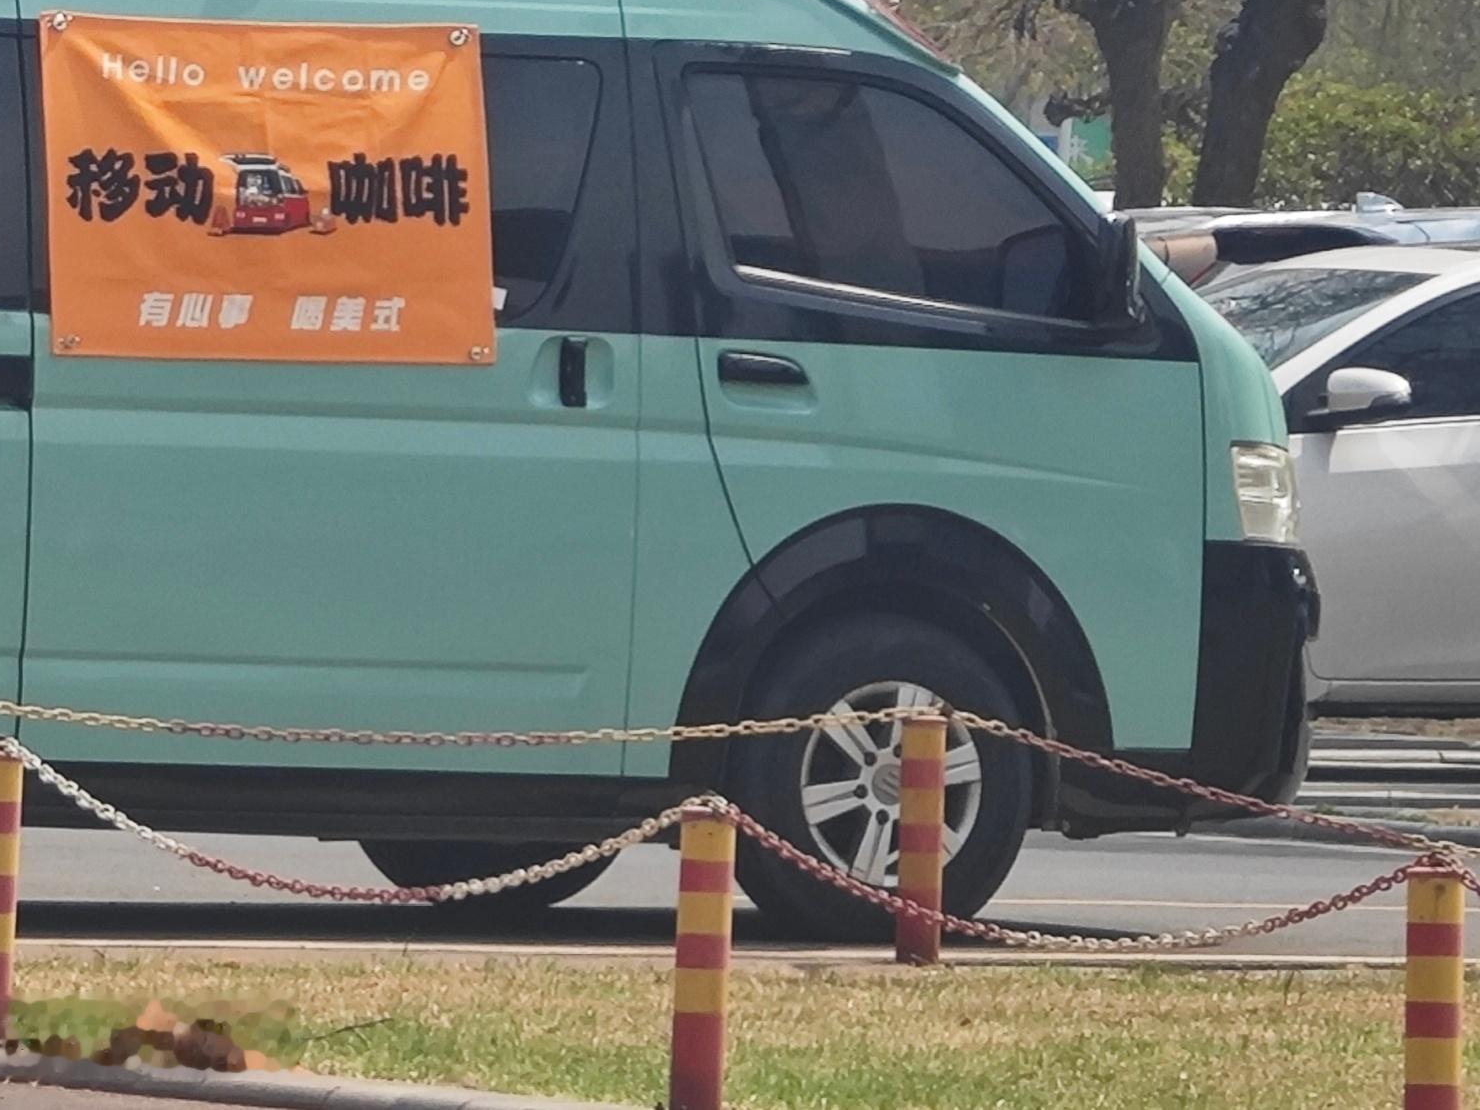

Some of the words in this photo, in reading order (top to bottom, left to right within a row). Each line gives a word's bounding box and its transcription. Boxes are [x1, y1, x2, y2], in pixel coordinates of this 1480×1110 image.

[100, 53, 206, 87] Hello
[238, 62, 431, 92] welcome
[66, 147, 215, 225] 移动
[327, 152, 471, 227] 咖啡
